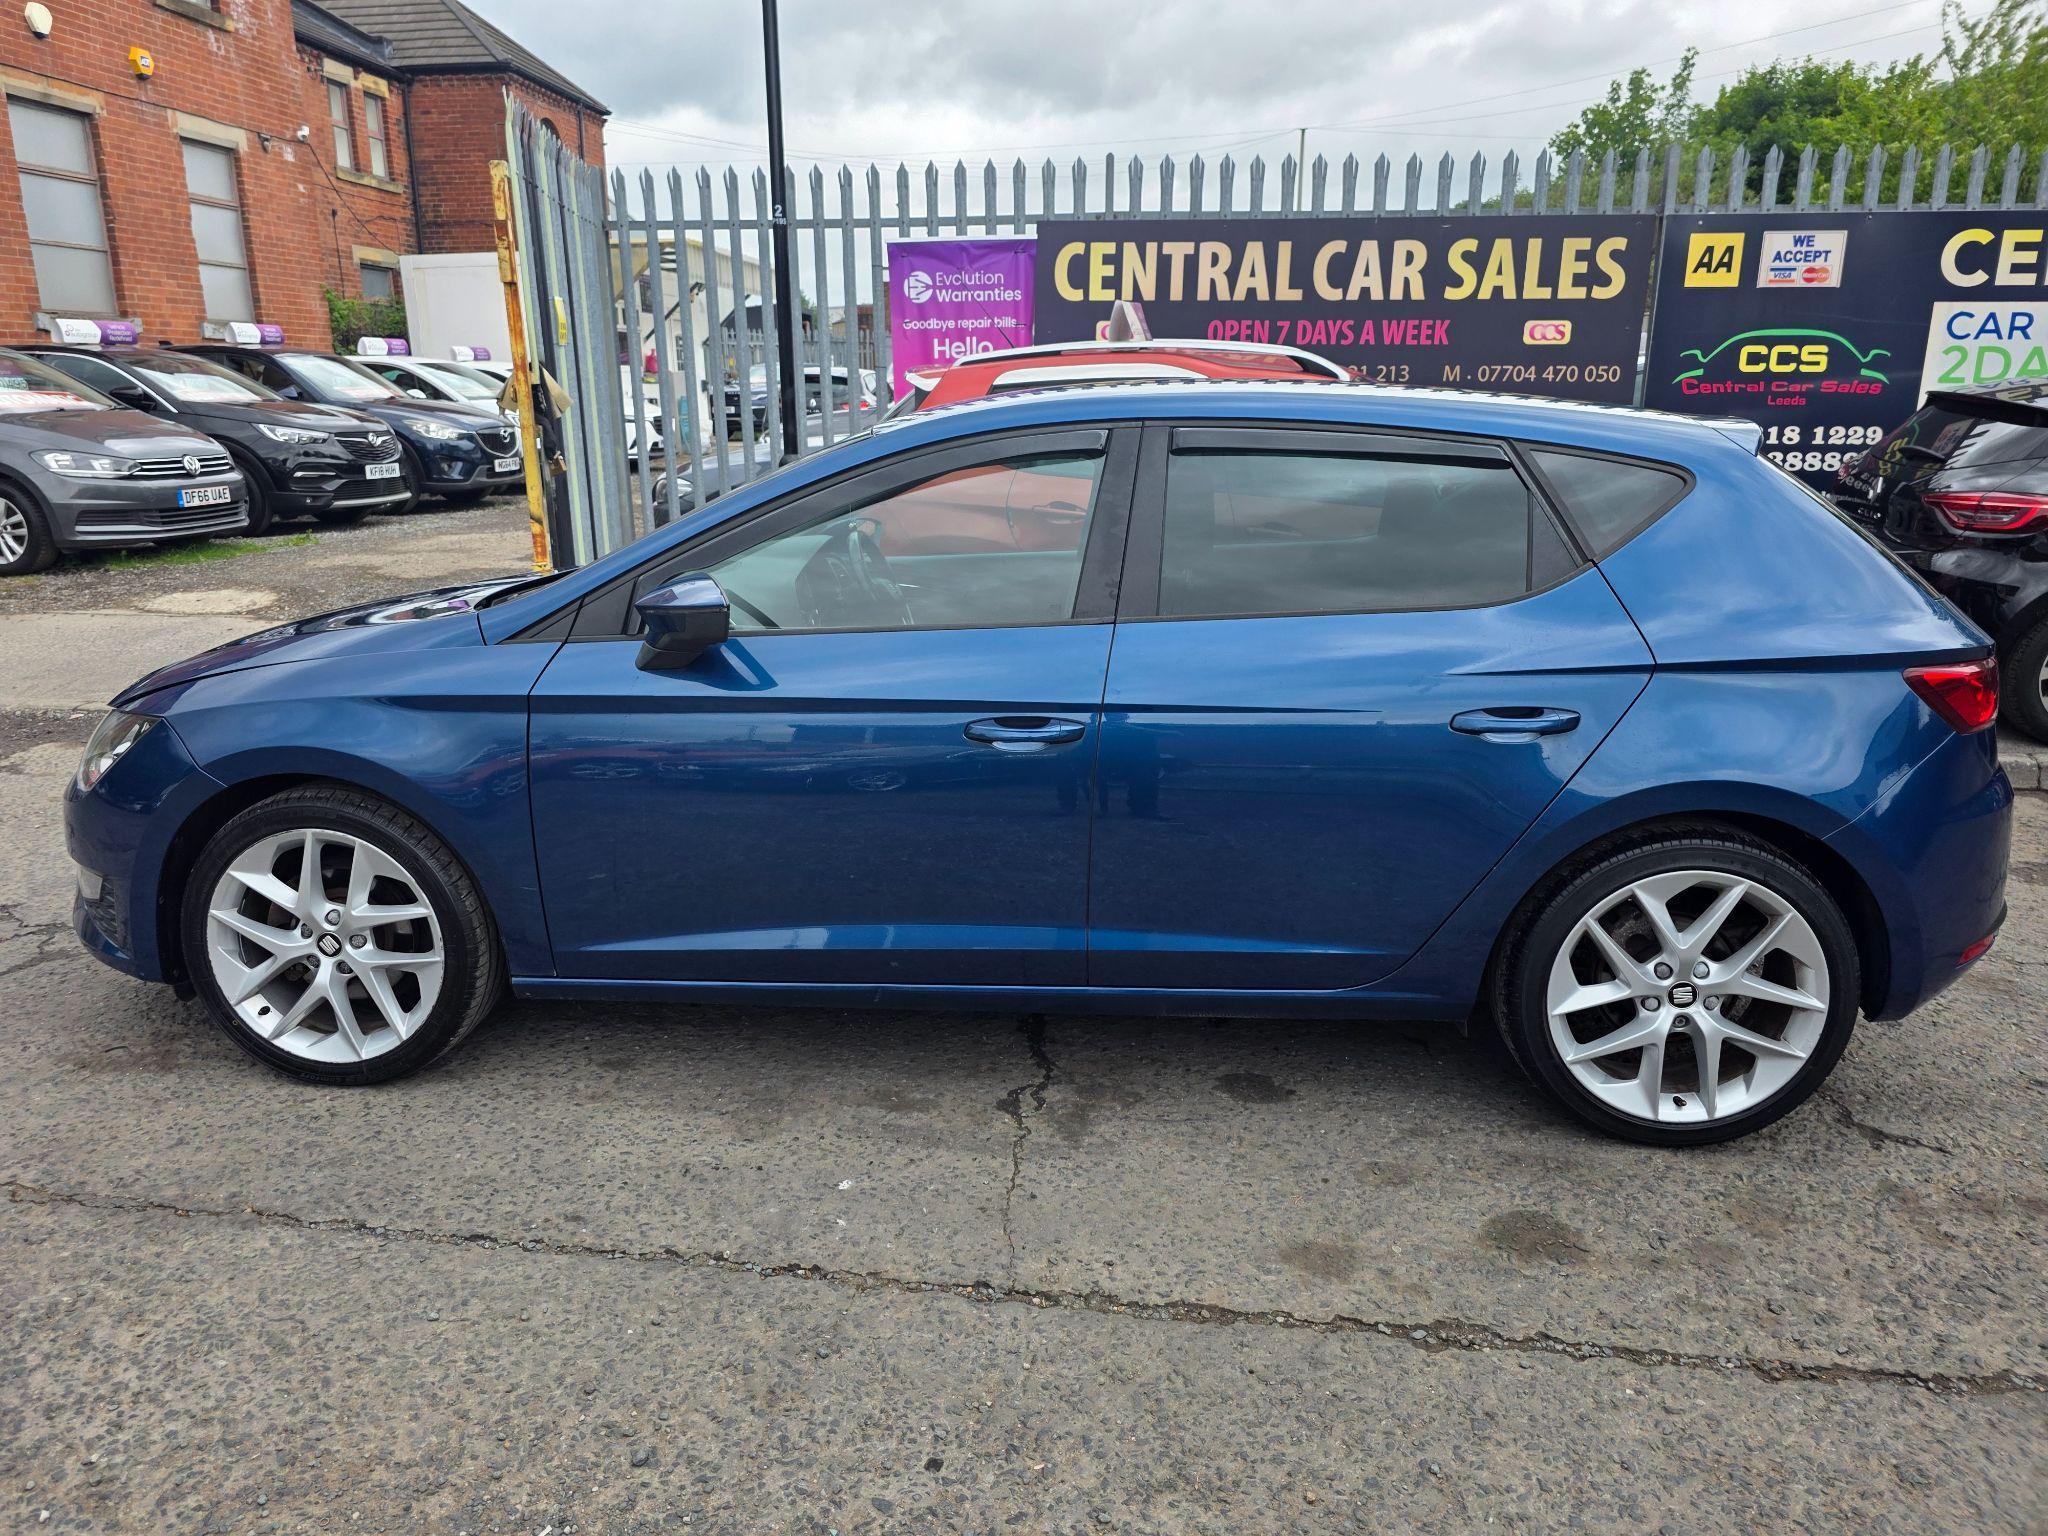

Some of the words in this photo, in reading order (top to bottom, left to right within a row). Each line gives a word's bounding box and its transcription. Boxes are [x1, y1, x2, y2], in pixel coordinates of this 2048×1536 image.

[774, 204, 783, 217] 2
[1792, 234, 1816, 248] WE
[1691, 245, 1735, 274] AA
[1771, 250, 1832, 263] ACCEPT
[1940, 228, 2048, 288] CE
[1054, 241, 1303, 302] CENTRAL
[1313, 239, 1428, 302] CAR
[1443, 237, 1628, 301] SALES
[935, 271, 1004, 287] Evolution
[935, 286, 1022, 303] Warranties
[903, 317, 955, 332] Goodbye
[957, 317, 992, 331] repair
[1207, 319, 1270, 343] OPEN
[1277, 320, 1291, 345] 7
[1296, 319, 1355, 345] DAYS
[1359, 320, 1376, 345] A
[1382, 319, 1451, 345] WEEK
[1528, 323, 1567, 341] CCS
[1946, 311, 2035, 341] CAR
[933, 336, 994, 359] Hello
[1738, 345, 1830, 373] CCS
[1376, 364, 1410, 382] 213
[1442, 365, 1461, 382] M
[1477, 365, 1536, 382] 07704
[1542, 365, 1579, 382] 470
[1584, 365, 1621, 383] 050
[1681, 378, 1765, 395] Central
[1771, 381, 1814, 393] Car
[1819, 380, 1883, 395] Sales
[1767, 395, 1807, 406] Leeds
[1811, 425, 1884, 446] 1229
[184, 489, 210, 504] DF66
[210, 487, 229, 501] UAE
